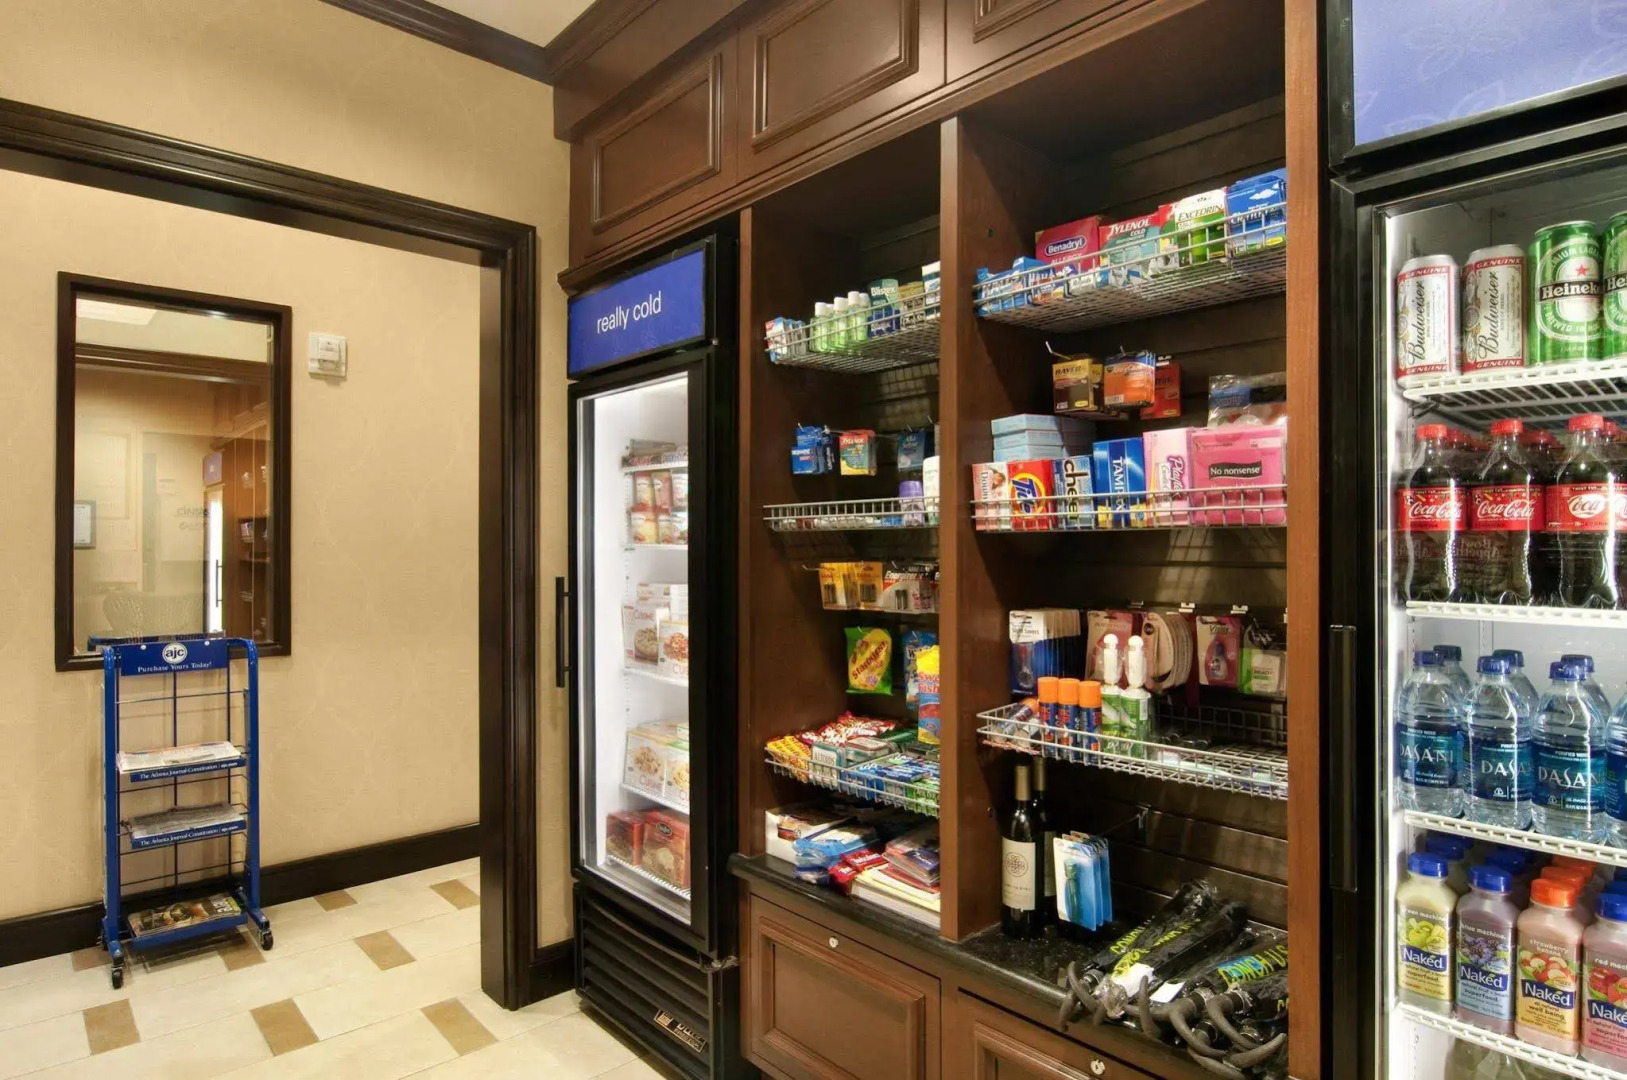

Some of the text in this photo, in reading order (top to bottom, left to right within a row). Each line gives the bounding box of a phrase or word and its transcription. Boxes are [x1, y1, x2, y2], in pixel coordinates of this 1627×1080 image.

[1178, 204, 1223, 220] EXCEDRIN
[1106, 218, 1150, 240] TYLENOL
[1048, 238, 1083, 254] Benadryl
[1476, 258, 1521, 268] GENUINE
[1405, 267, 1448, 278] GENUINE
[597, 290, 662, 334] really cold
[1478, 271, 1500, 360] Budweiser
[1407, 280, 1426, 365] Budweiser
[1406, 365, 1448, 374] GENUINE
[1476, 360, 1521, 368] GENUINE
[1210, 466, 1260, 475] No nonsense
[981, 471, 990, 503] Down
[1012, 478, 1038, 514] Tide
[1477, 499, 1536, 518] Coca-Cola
[165, 648, 185, 659] ajc
[138, 665, 168, 673] Purchase
[191, 661, 212, 669] Today!
[151, 770, 169, 778] Atlanta
[1529, 939, 1568, 954] strawberry
[1403, 947, 1445, 969] Naked
[1460, 965, 1505, 988] Naked
[1525, 982, 1572, 1007] Naked
[1529, 1004, 1543, 1012] well
